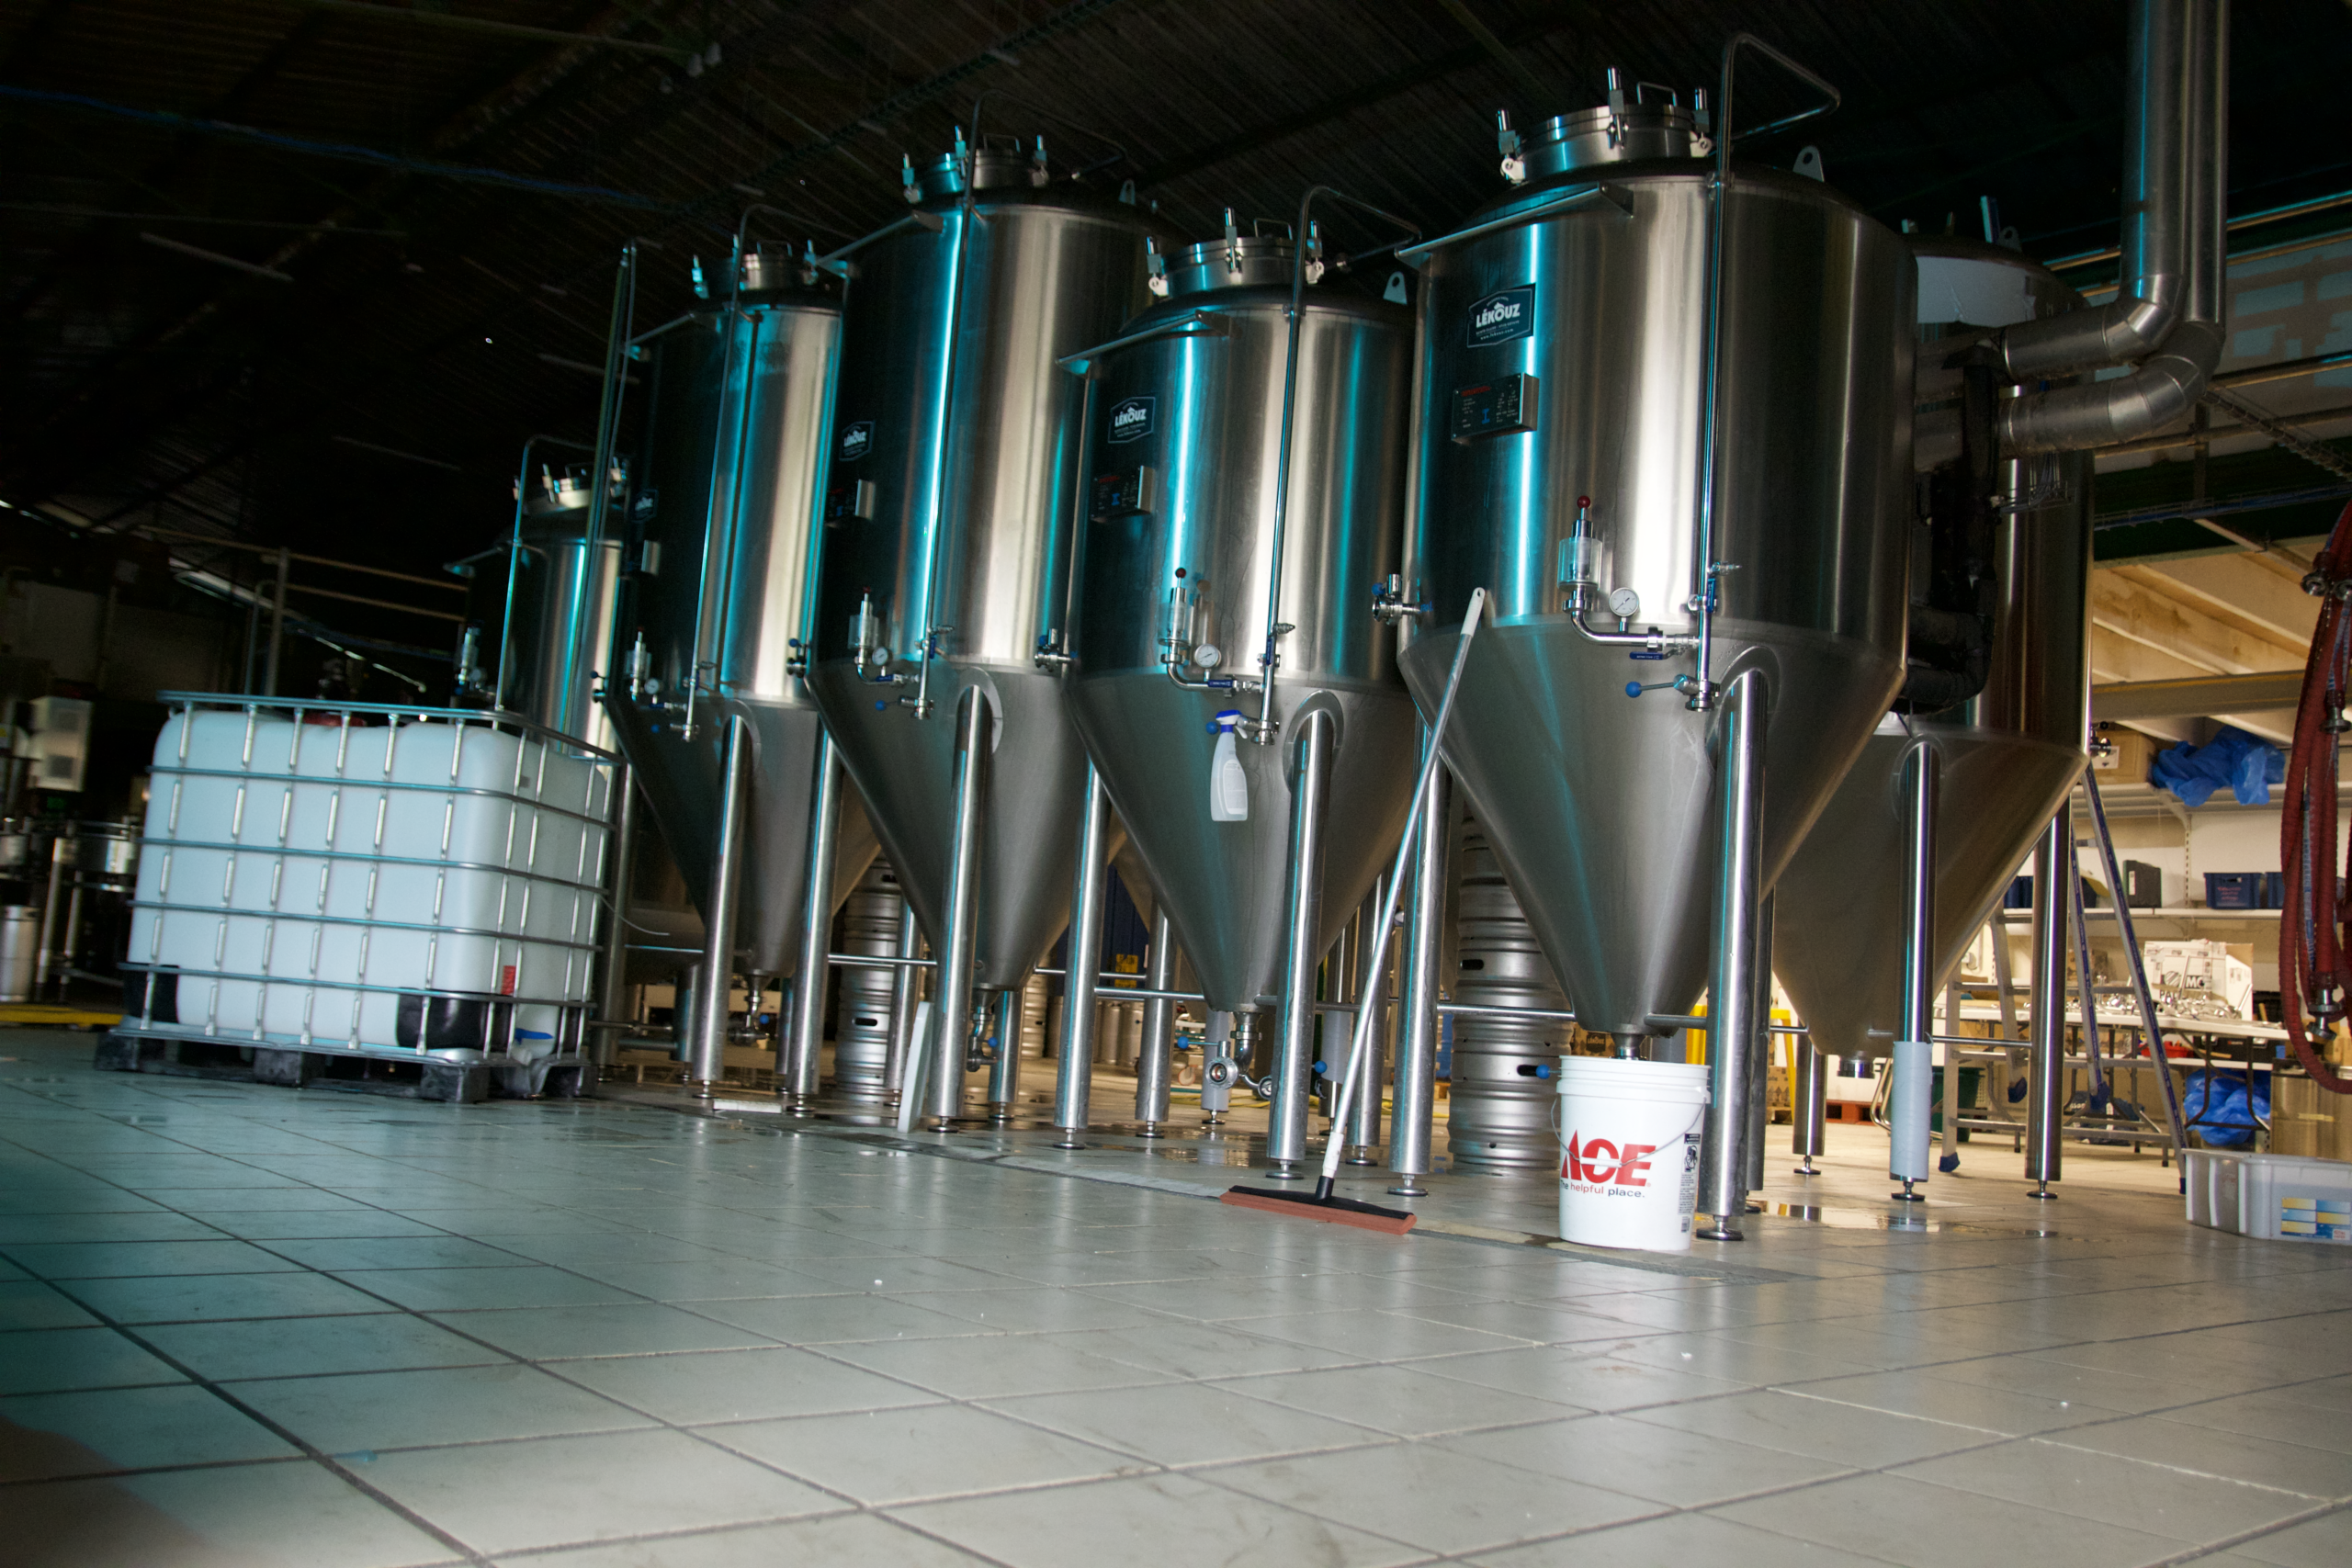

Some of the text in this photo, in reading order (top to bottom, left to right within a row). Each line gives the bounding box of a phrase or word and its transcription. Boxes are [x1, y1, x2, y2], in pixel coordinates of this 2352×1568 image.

[1560, 1129, 1657, 1187] ACE
[1570, 1182, 1604, 1194] helpful
[1608, 1188, 1645, 1198] place.
